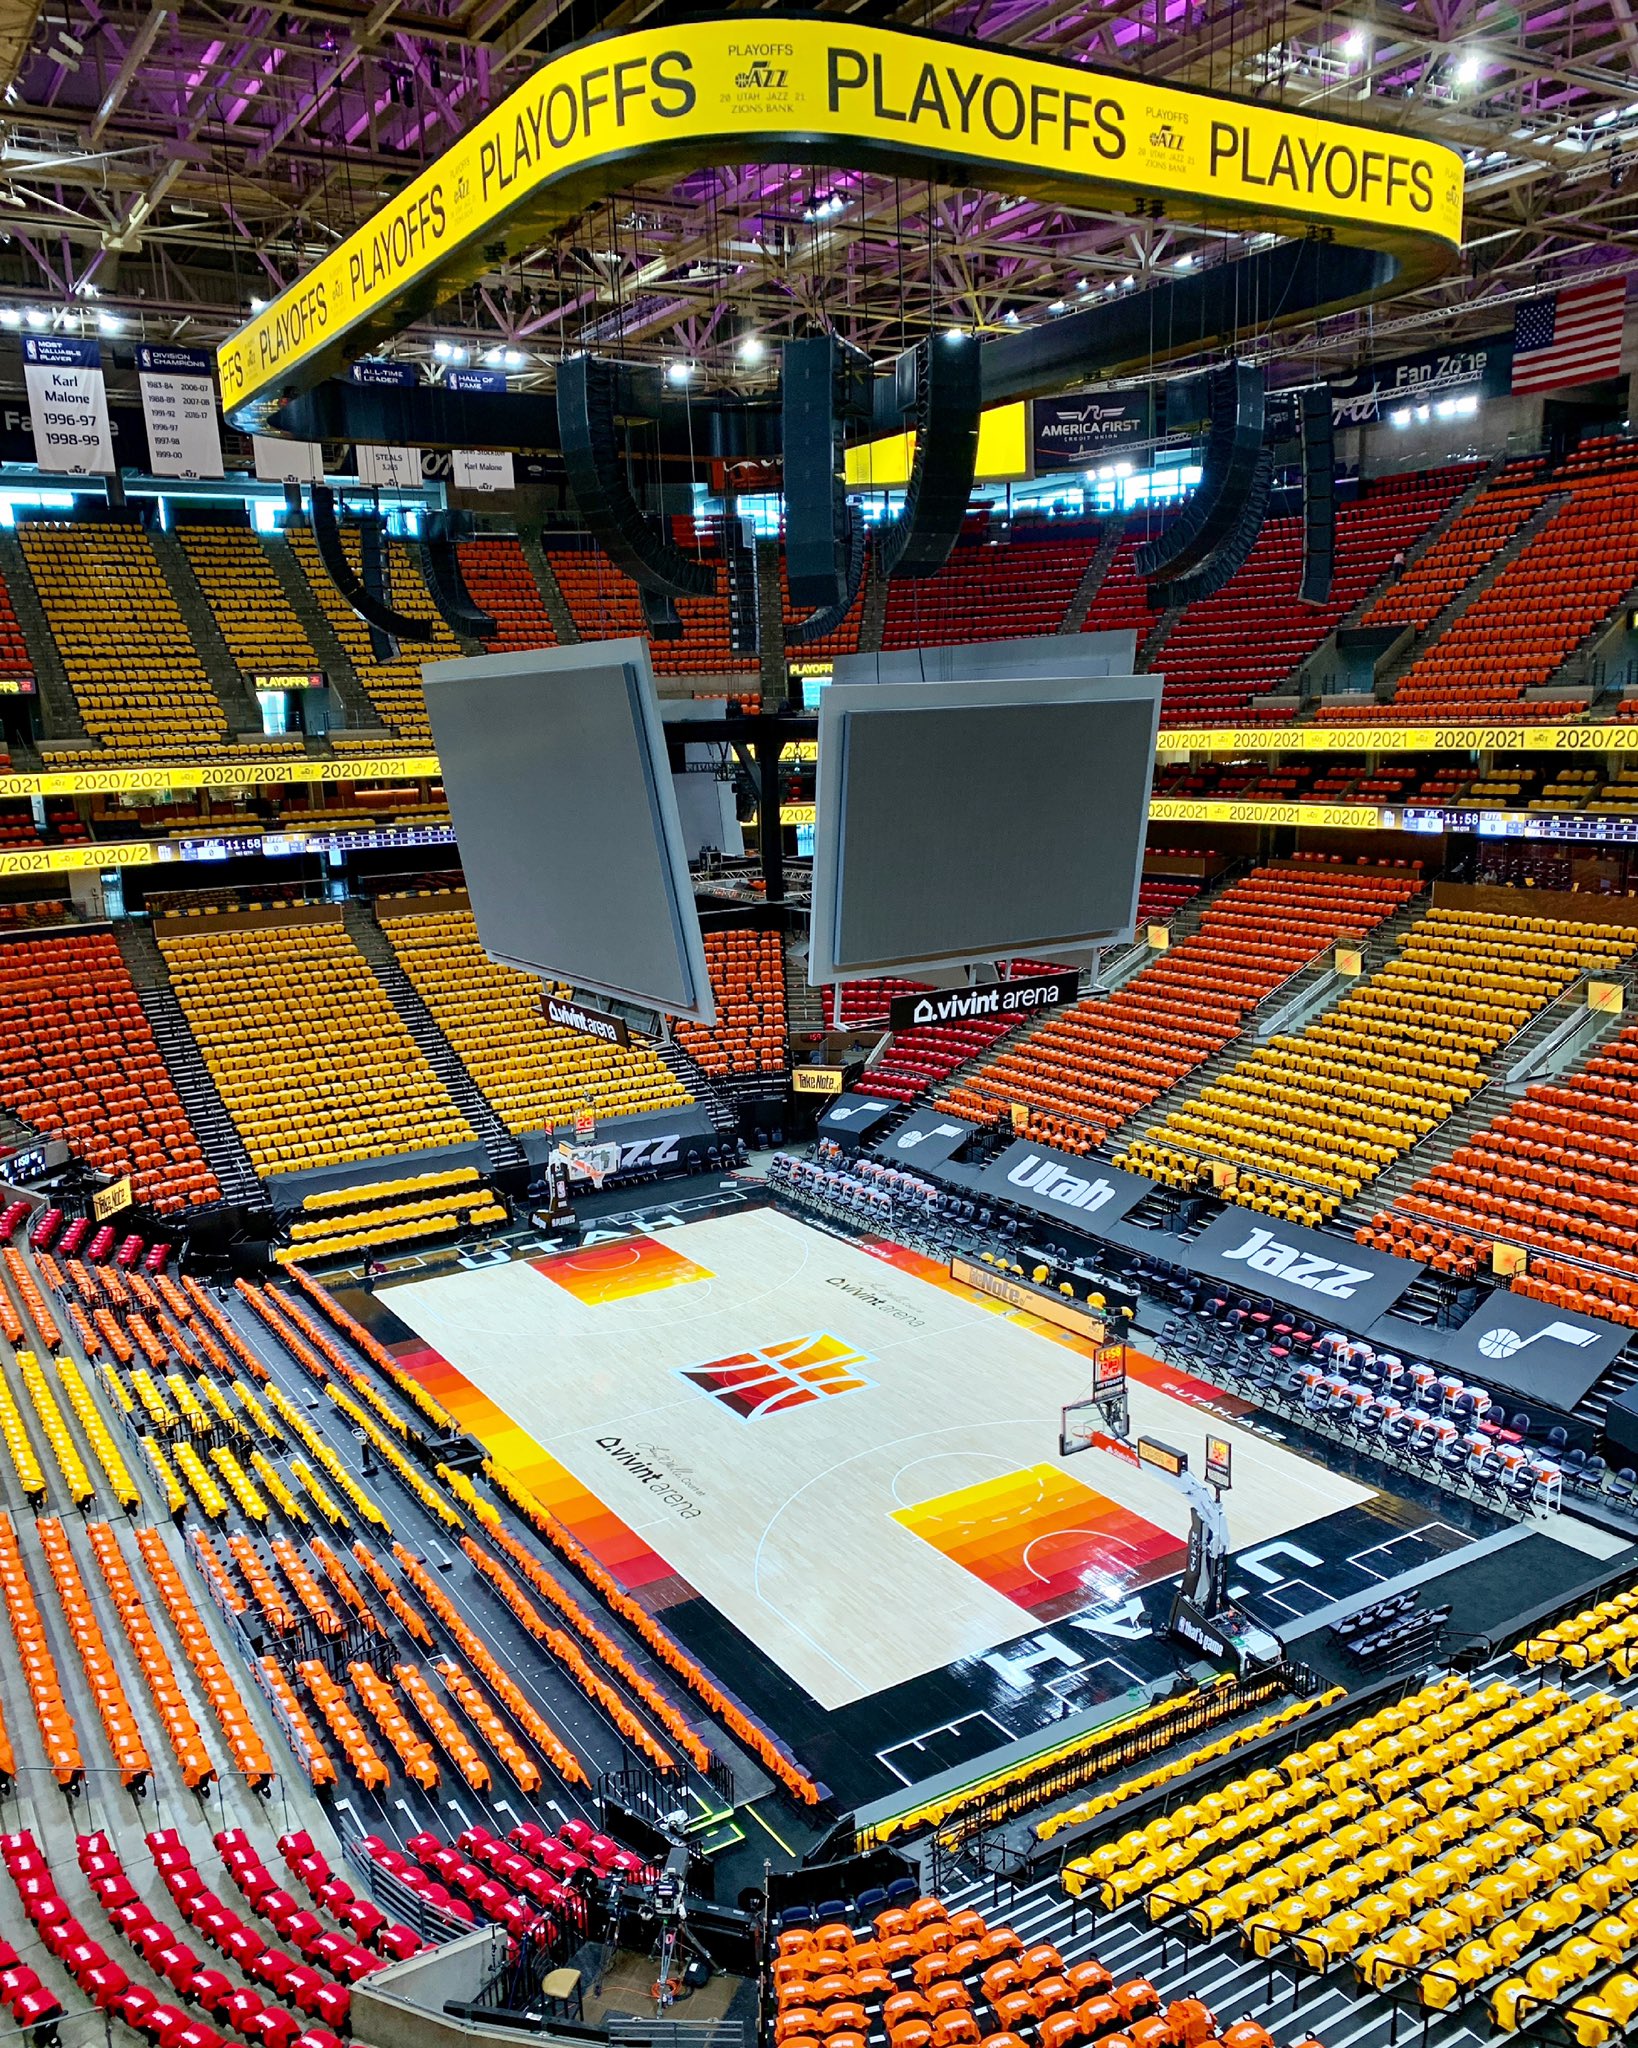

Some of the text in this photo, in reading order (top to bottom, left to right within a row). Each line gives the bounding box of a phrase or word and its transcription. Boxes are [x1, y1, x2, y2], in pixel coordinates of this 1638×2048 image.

[728, 44, 794, 56] PLAYOFFS
[737, 93, 760, 101] UTAH
[767, 92, 788, 101] JAZZ
[827, 47, 1126, 160] PLAYOFFS
[731, 104, 794, 114] ZIONS BANK
[1146, 107, 1189, 124] PLAYOFFS
[480, 50, 697, 203] PLAYOFFS
[1210, 121, 1434, 215] PLAYOFFS
[348, 183, 446, 303] PLAYOFFS
[259, 282, 328, 371] PLAYOFFS
[39, 348, 82, 357] VALUABLE
[40, 354, 72, 362] PLAYER
[152, 351, 191, 360] DIVISION
[153, 359, 206, 367] CHAMPIONS
[52, 374, 78, 387] Karl
[363, 368, 403, 377] ALL-TIME
[363, 375, 398, 384] LEADER
[459, 375, 480, 383] HALL
[1396, 365, 1431, 387] Fan
[44, 390, 90, 404] Malone
[43, 412, 97, 427] 1996-97
[1041, 419, 1141, 437] AMERICA FIRST
[45, 432, 100, 446] 1998-99
[375, 453, 403, 462] STEALS
[464, 463, 503, 471] Karl Malone
[256, 676, 309, 688] PLAYOFFS
[1233, 732, 1305, 748] 2020/2021
[1328, 731, 1408, 748] 2020/2021
[1435, 730, 1525, 748] 2020/2021
[74, 771, 172, 791] 2020/2021
[202, 767, 294, 784] 2020/2021
[321, 761, 406, 779] 2020/2021
[1229, 805, 1300, 823] 2020/2021
[1323, 809, 1376, 826] 2020/2
[1444, 813, 1479, 824] 11:58
[226, 838, 261, 850] 11:58
[83, 846, 149, 866] 2020/2
[1002, 985, 1059, 1010] arena
[587, 1017, 617, 1041] arena
[798, 1073, 835, 1090] Take Note
[621, 1134, 681, 1166] ZZ
[1006, 1153, 1116, 1212] Utah
[457, 1214, 687, 1270] UTAH
[1221, 1226, 1375, 1301] Jazz
[878, 1304, 926, 1328] arena
[1160, 1382, 1287, 1441] @UTAHJAZZ
[649, 1482, 701, 1520] arena
